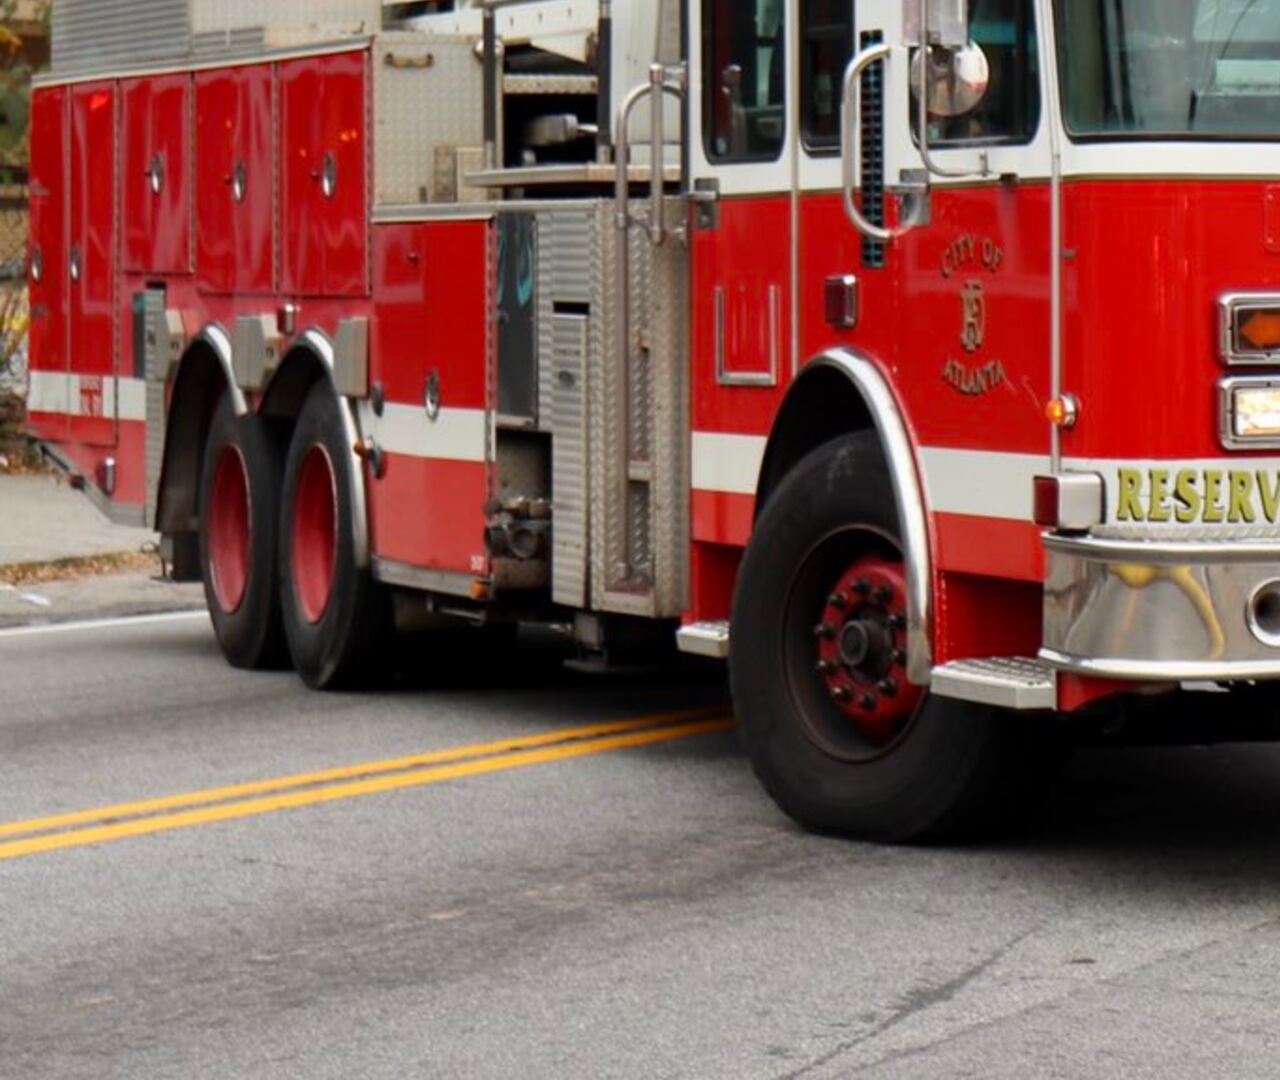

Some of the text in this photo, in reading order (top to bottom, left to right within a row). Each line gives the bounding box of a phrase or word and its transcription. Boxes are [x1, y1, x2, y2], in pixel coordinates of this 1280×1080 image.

[941, 233, 1004, 278] CITY OF
[941, 360, 1005, 396] ATLANTA
